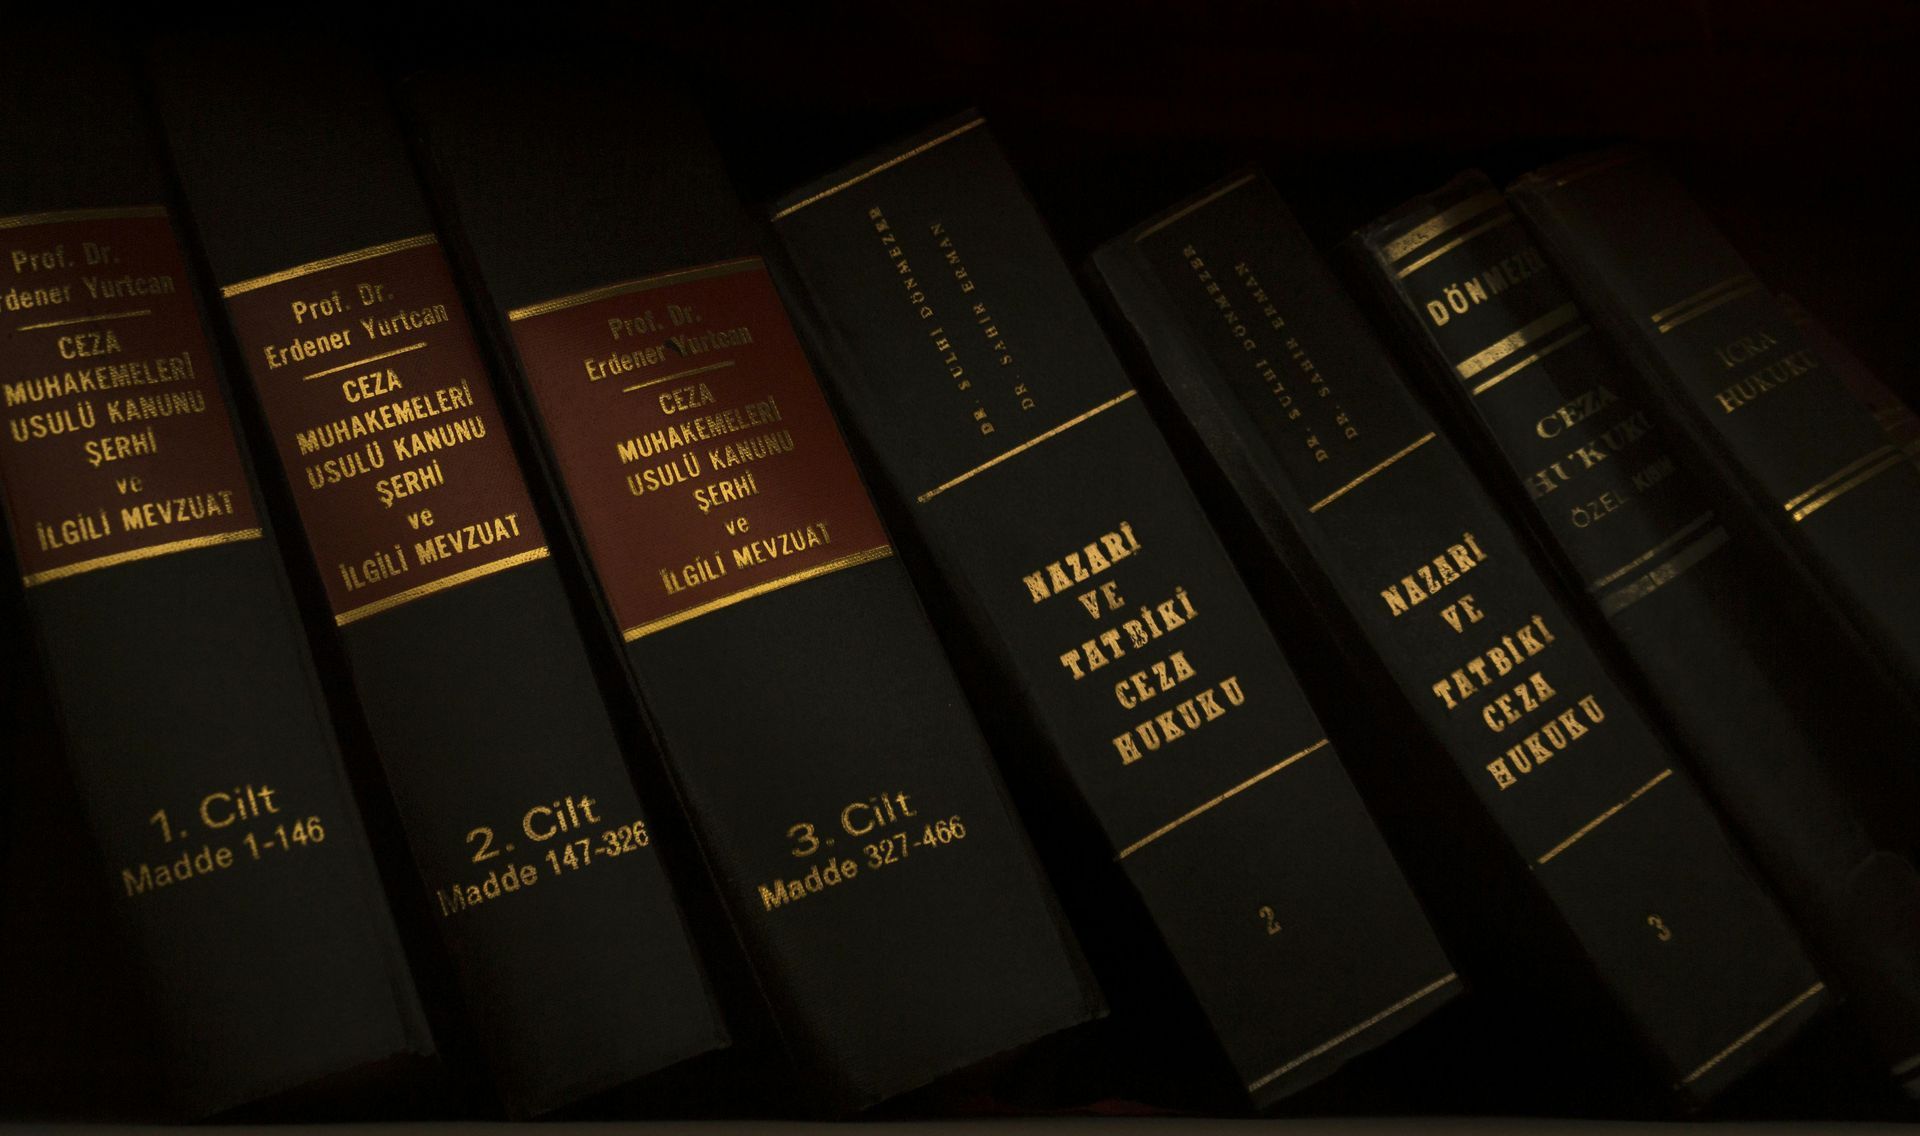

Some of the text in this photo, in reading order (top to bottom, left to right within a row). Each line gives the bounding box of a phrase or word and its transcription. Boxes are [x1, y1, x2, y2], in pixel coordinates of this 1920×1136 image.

[11, 241, 120, 274] Prof. Dr.
[83, 273, 176, 301] Yurtcan
[290, 282, 394, 325] Prof. Dr.
[57, 329, 122, 360] CEZA
[262, 304, 448, 370] Erdener Yurtcan
[608, 303, 701, 341] Prof. Dr.
[2, 352, 195, 407] MUHAKEMELERİ
[341, 368, 403, 404] CEZA
[584, 344, 666, 382] Erdener
[10, 390, 206, 444] USULÜ KANUNU
[295, 378, 474, 456] MUHAKEMELERİ
[658, 382, 716, 416] CEZA
[1535, 384, 1619, 439] CEZA
[84, 427, 158, 467] ŞERHİ
[305, 416, 487, 491] USULÜ KANUNU
[615, 394, 783, 465] MUHAKEMELERİ
[115, 474, 143, 495] ve
[375, 459, 445, 509] ŞERHİ
[627, 429, 796, 497] USULÜ KANUNU
[35, 490, 234, 552] İLGİLİ MEVZUAT
[407, 507, 435, 531] ve
[694, 470, 760, 516] ŞERHİ
[1570, 489, 1630, 528] ÖZEL
[338, 512, 521, 592] İLGİLİ MEVZUAT
[725, 515, 750, 538] ve
[659, 521, 831, 596] İLGİLİ MEVZUAT
[1022, 520, 1143, 605] NAZARİ
[1379, 531, 1489, 619] NAZARİ
[1077, 579, 1126, 621] VE
[1439, 593, 1486, 635] VE
[1058, 585, 1200, 682] TATBİKİ
[1431, 613, 1556, 711] TATBİKİ
[1114, 650, 1198, 711] CEZA
[1482, 670, 1558, 734] CEZA
[1112, 675, 1246, 767] HUKUKU
[1486, 693, 1606, 792] HUKUKU
[149, 783, 280, 844] 1. Cilt
[465, 793, 602, 864] 2. Cilt
[786, 790, 918, 858] 3. Cilt
[120, 816, 327, 897] Madde 1-146
[436, 820, 650, 918] Madde 147-326
[757, 814, 967, 912] Madde 327-466
[1257, 904, 1282, 936] 2
[1645, 911, 1674, 943] 3
